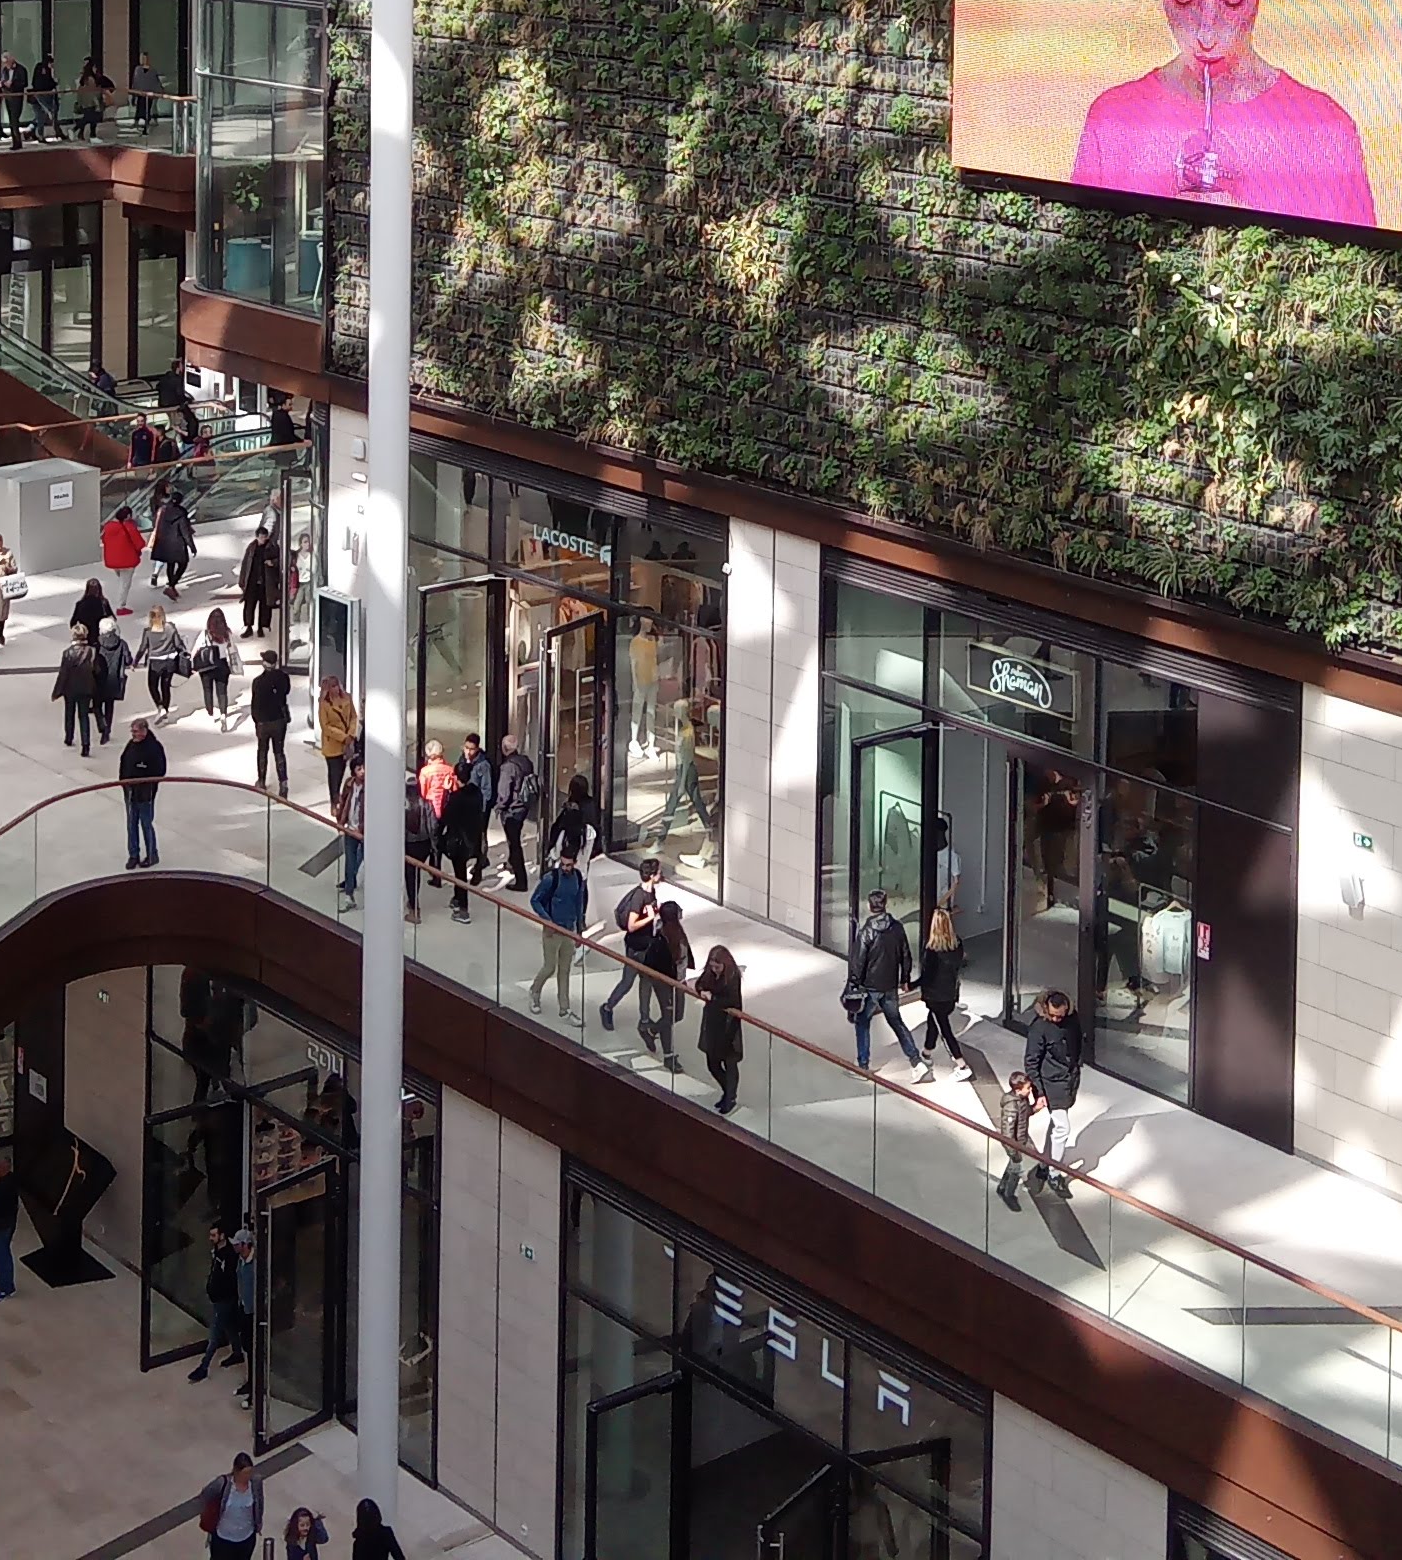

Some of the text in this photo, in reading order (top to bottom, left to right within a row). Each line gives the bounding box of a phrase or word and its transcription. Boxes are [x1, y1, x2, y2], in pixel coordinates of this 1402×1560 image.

[533, 523, 595, 558] LACOSTE
[989, 657, 1053, 709] Shaman
[663, 1242, 910, 1427] ESLA
